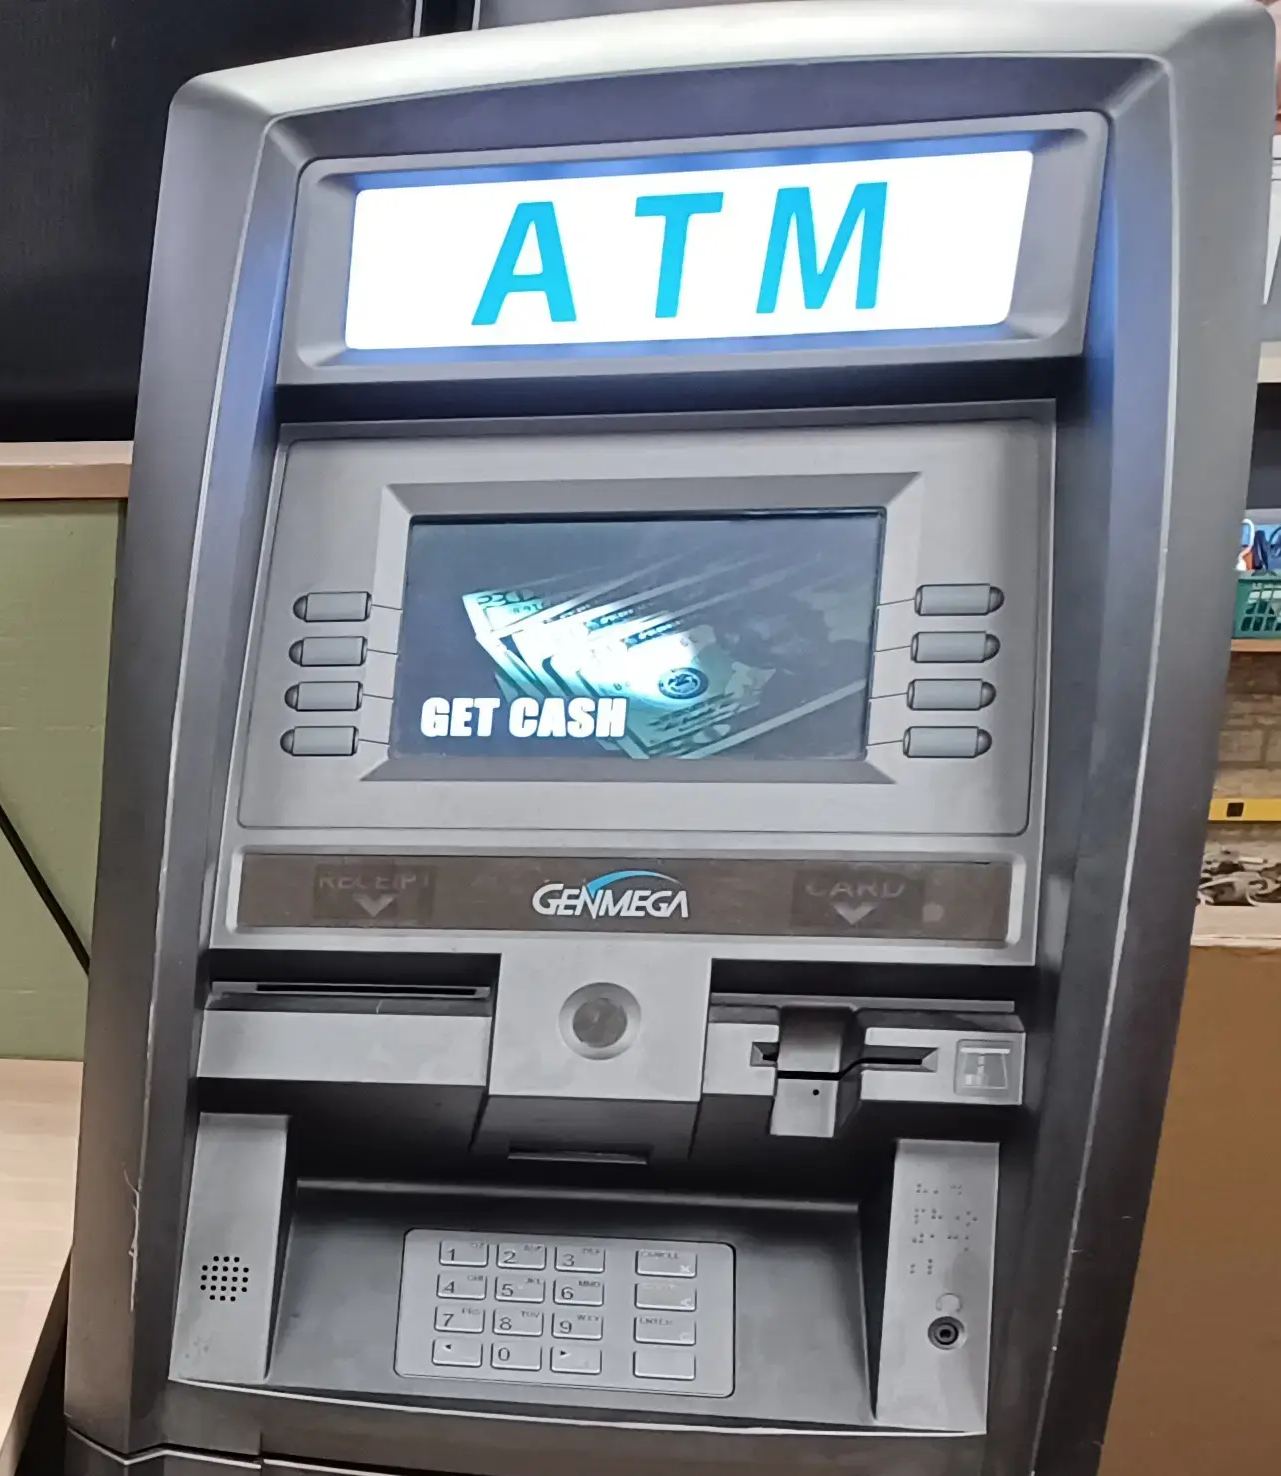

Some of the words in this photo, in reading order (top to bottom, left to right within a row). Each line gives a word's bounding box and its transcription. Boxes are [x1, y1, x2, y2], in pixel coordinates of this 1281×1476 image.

[471, 181, 888, 326] ATM
[420, 696, 500, 738] GET
[508, 696, 627, 738] CASH
[532, 883, 689, 919] GENMEGA
[447, 1248, 457, 1262] 1
[503, 1250, 518, 1264] 2
[562, 1254, 575, 1267] 3
[443, 1280, 456, 1294] 4
[501, 1283, 514, 1297] 5
[561, 1286, 575, 1300] 6
[442, 1313, 455, 1327] 7
[499, 1317, 513, 1330] 8
[559, 1320, 573, 1334] 9
[498, 1347, 511, 1362] 0
